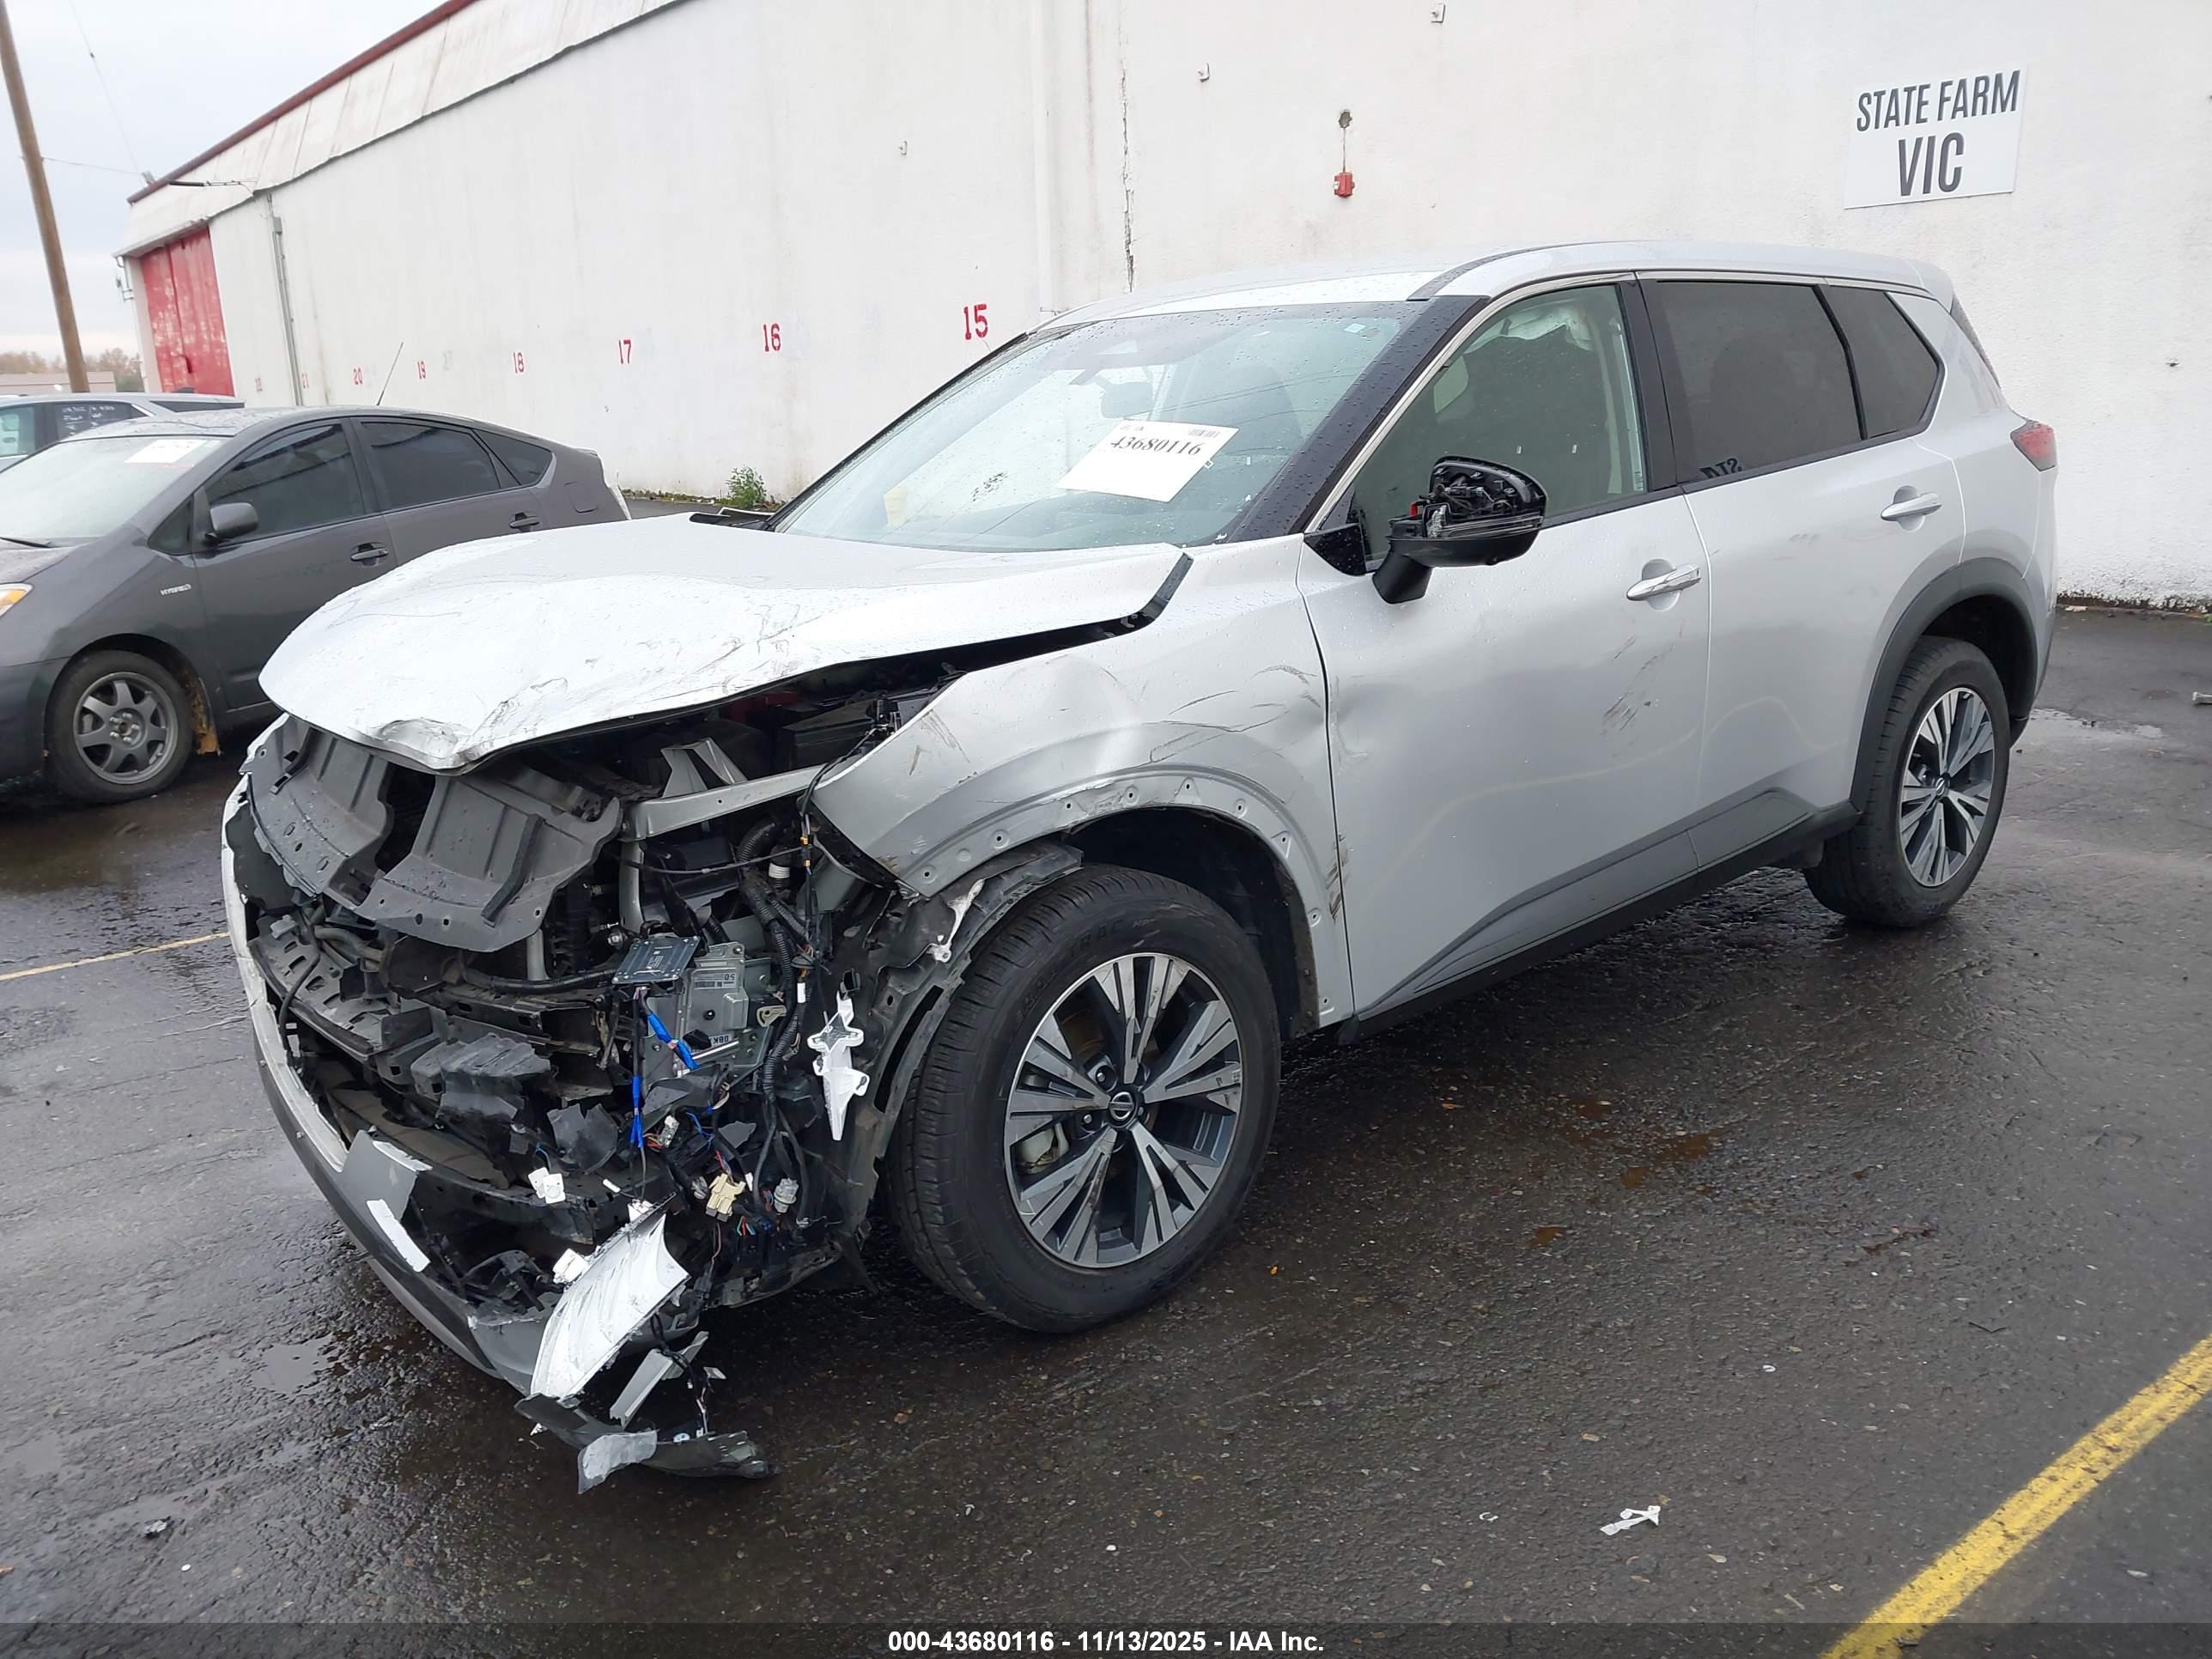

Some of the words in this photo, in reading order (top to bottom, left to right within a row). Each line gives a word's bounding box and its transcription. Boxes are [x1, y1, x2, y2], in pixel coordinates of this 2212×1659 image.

[1856, 83, 1931, 131] STATE
[1937, 70, 2021, 121] FARM
[1899, 131, 1965, 197] VIC
[963, 303, 988, 340] 15
[763, 323, 781, 352] 16
[513, 352, 524, 374] 18
[618, 339, 631, 364] 17
[353, 368, 363, 385] 20
[417, 361, 426, 380] 19
[1110, 435, 1206, 456] 43680116
